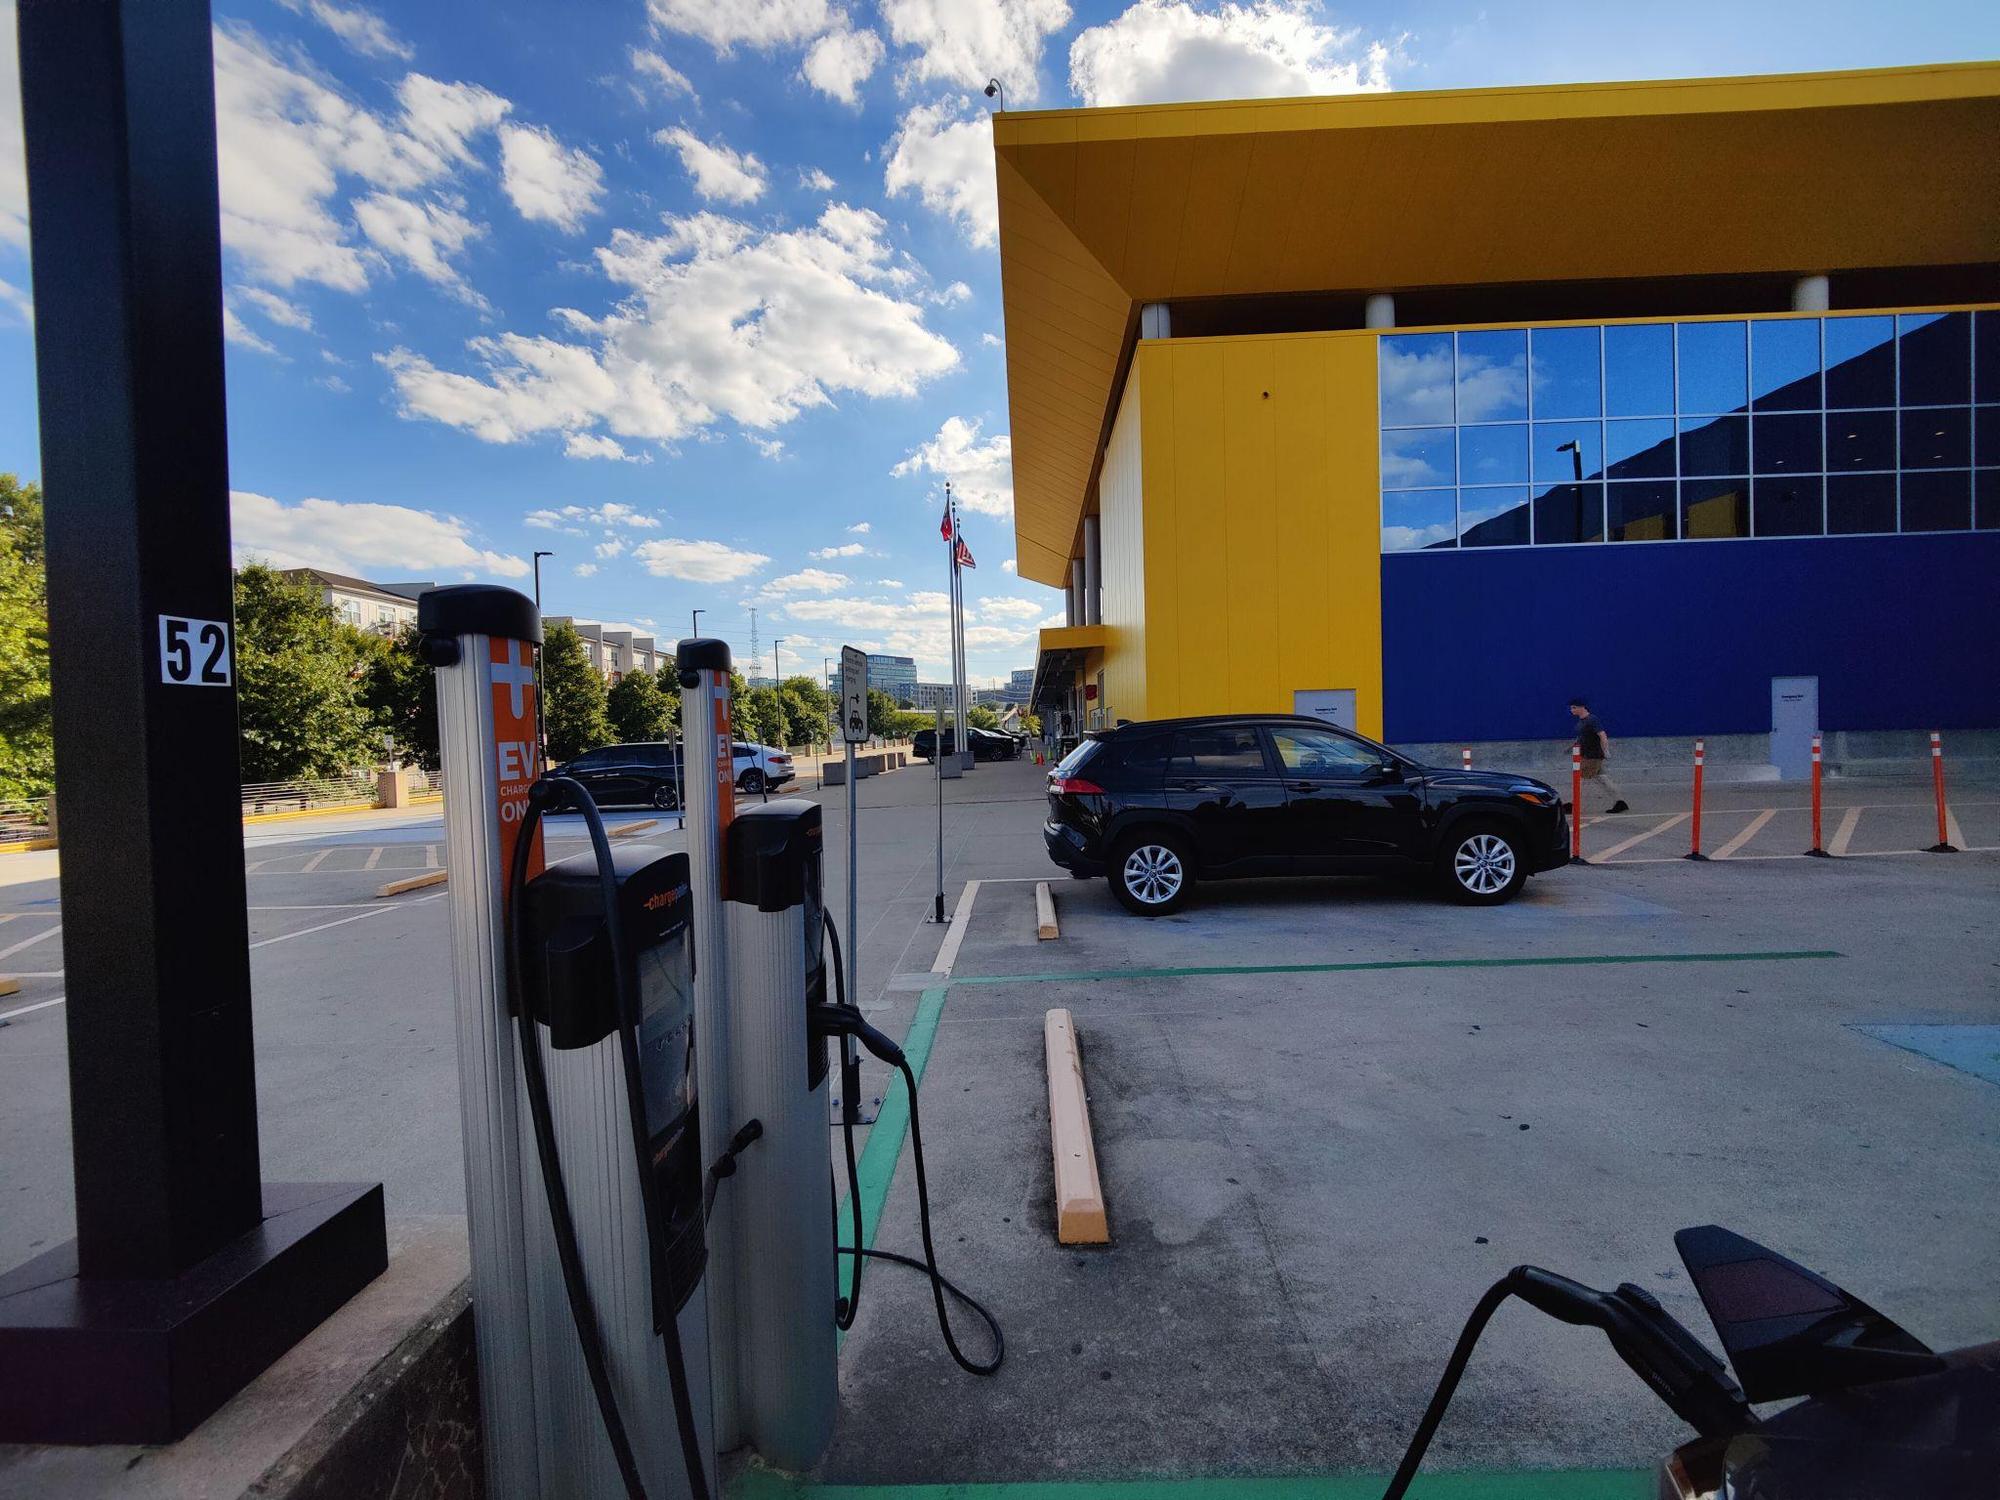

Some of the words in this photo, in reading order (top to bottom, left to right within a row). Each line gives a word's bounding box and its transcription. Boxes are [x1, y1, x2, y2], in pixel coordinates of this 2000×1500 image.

[166, 619, 227, 683] 52
[499, 741, 536, 780] EV
[501, 782, 531, 797] CHARG
[501, 800, 531, 822] ON
